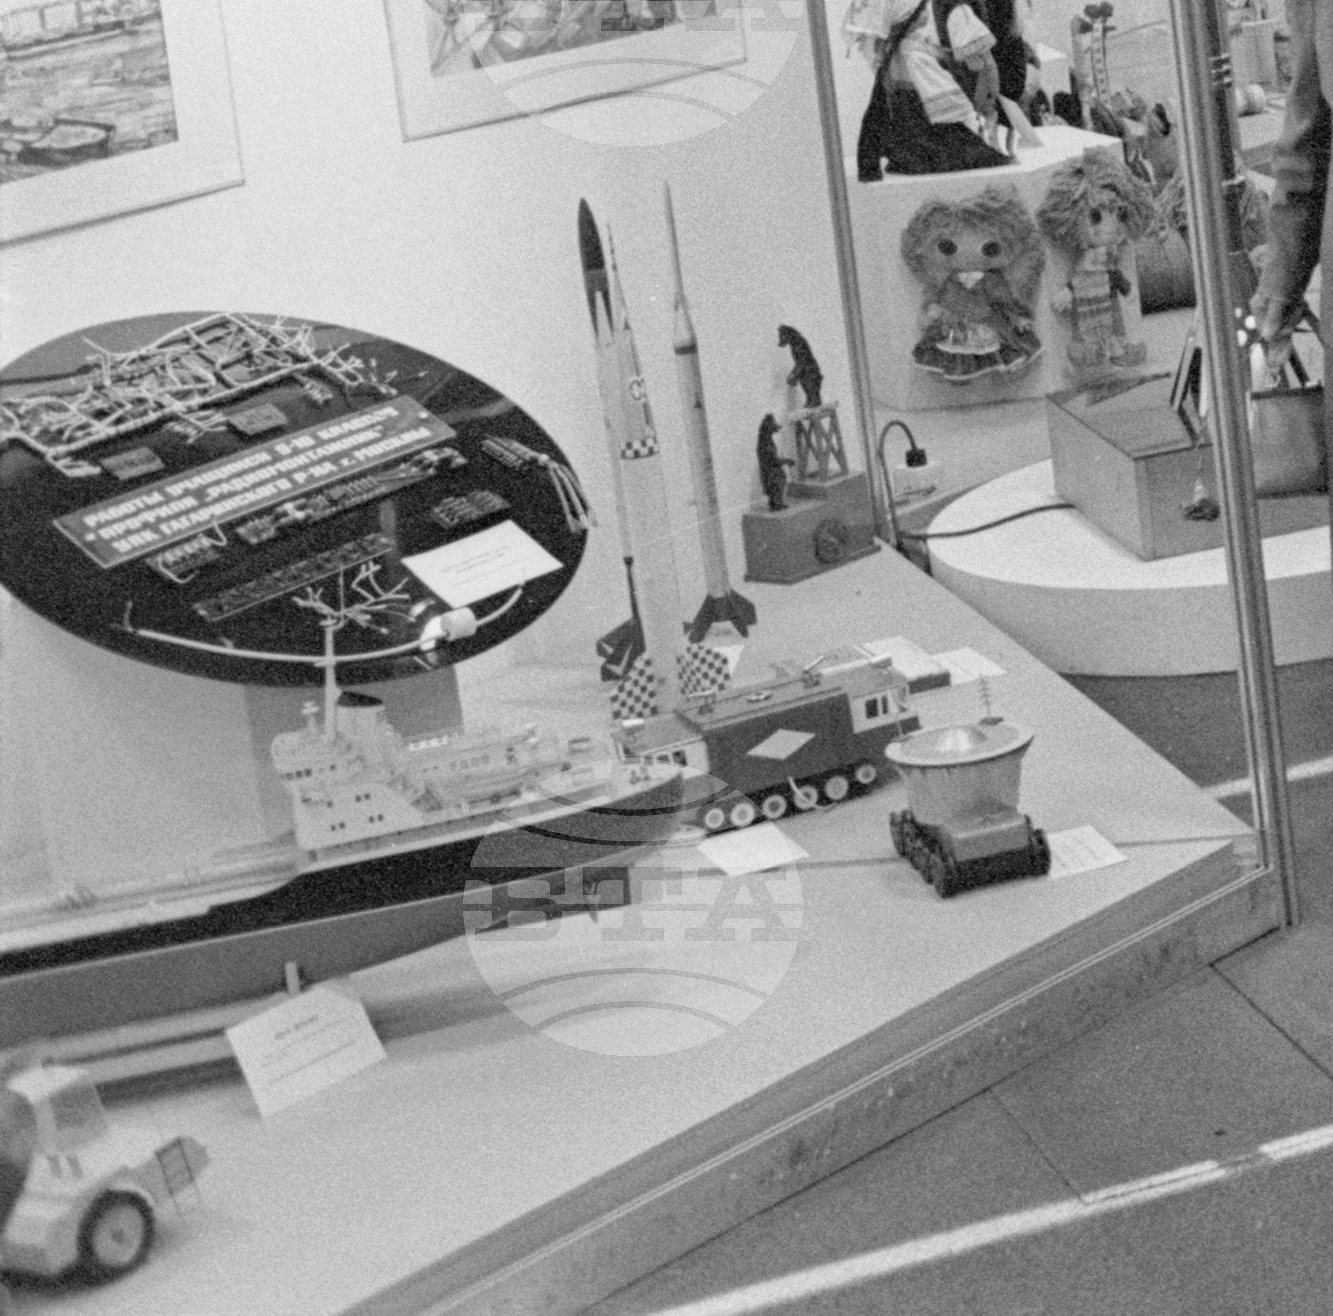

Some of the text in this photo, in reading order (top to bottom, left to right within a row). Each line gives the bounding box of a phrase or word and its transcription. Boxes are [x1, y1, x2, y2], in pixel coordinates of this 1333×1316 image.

[82, 491, 165, 527] РАБОТЫ
[163, 451, 273, 497] УЧАЩИХСЯ
[97, 495, 199, 540] ПРОФИЛЯ
[110, 528, 160, 553] УПК
[158, 478, 293, 535] ГАГАРИНСКОГО
[352, 426, 432, 461] МОСКВЫ
